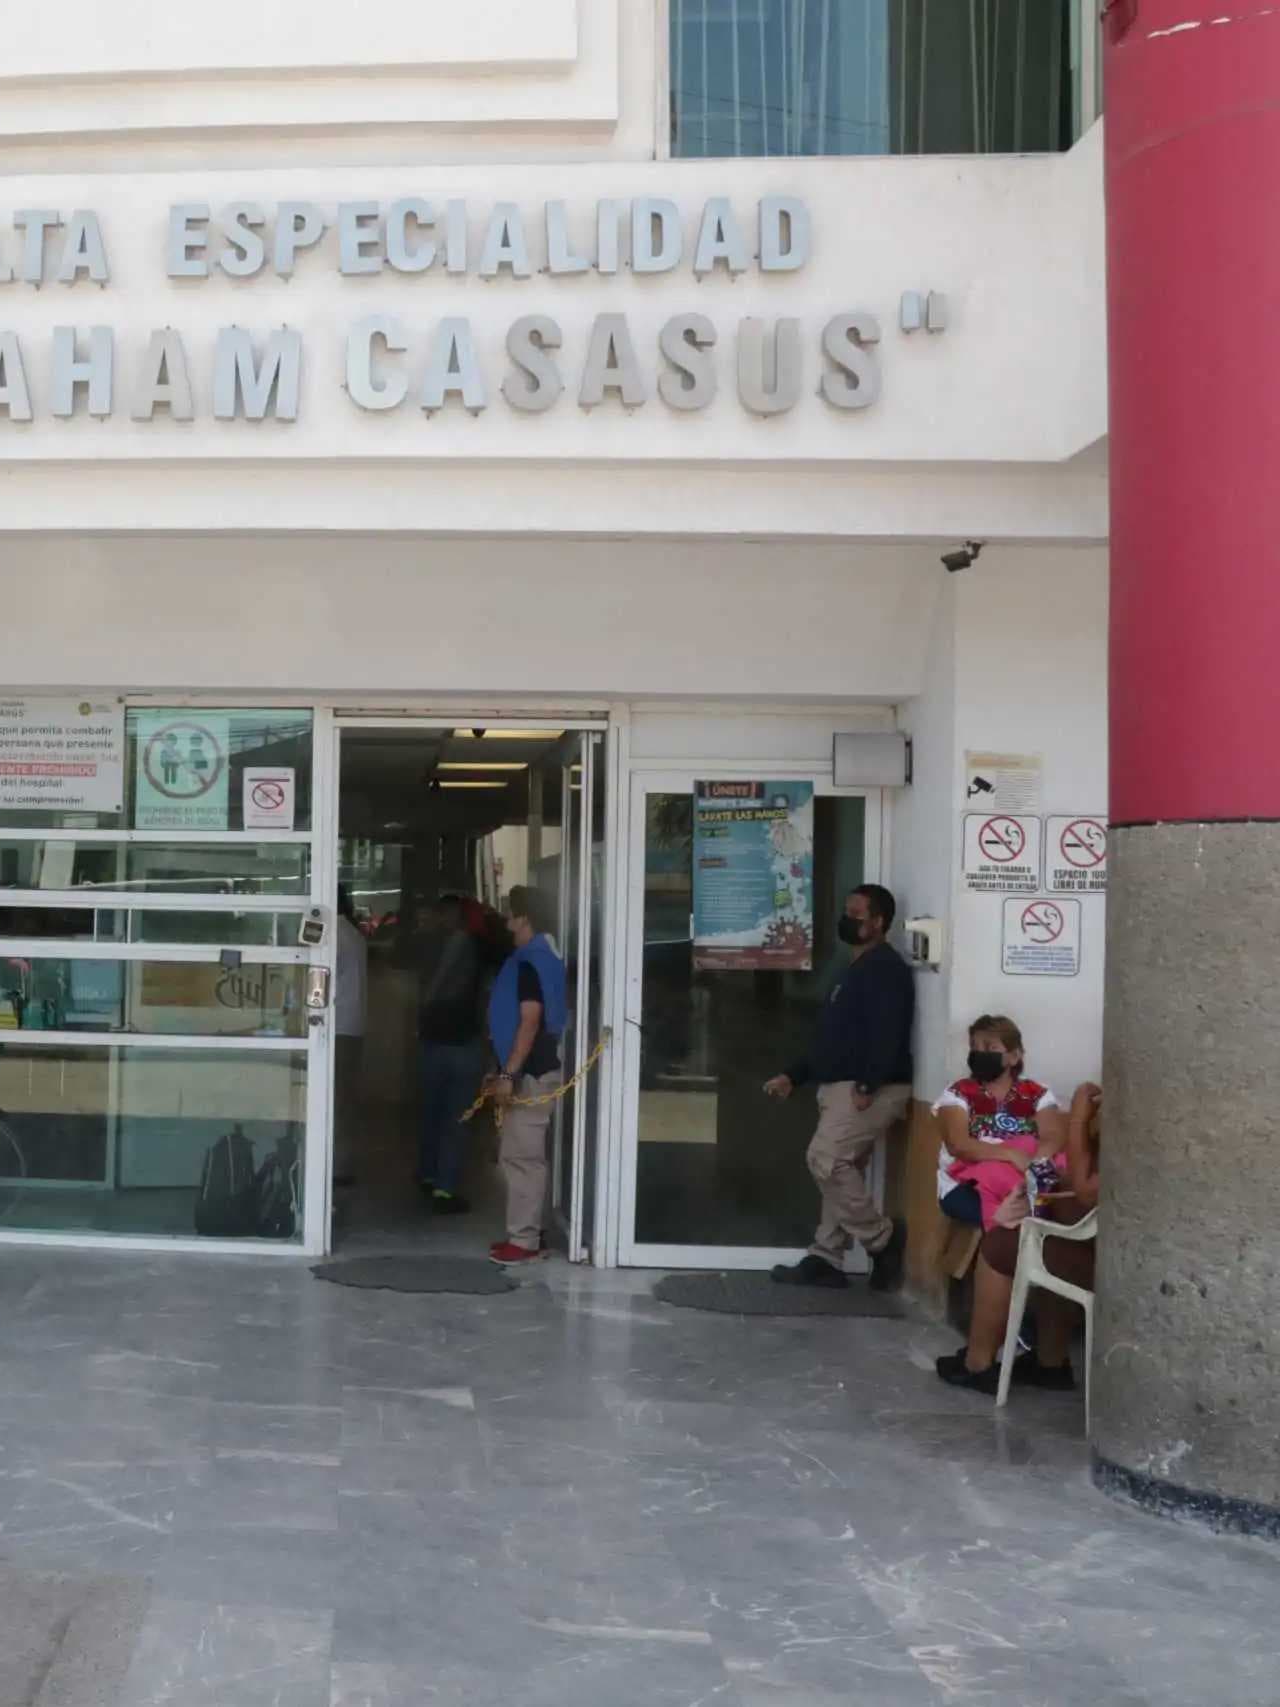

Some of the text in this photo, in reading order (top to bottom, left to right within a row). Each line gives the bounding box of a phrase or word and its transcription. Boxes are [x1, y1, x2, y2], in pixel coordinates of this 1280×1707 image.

[167, 197, 813, 279] ESPECIALIDAD
[1053, 869, 1088, 879] ESPACIO
[1053, 880, 1075, 890] LIBRE
[1077, 880, 1086, 890] DE
